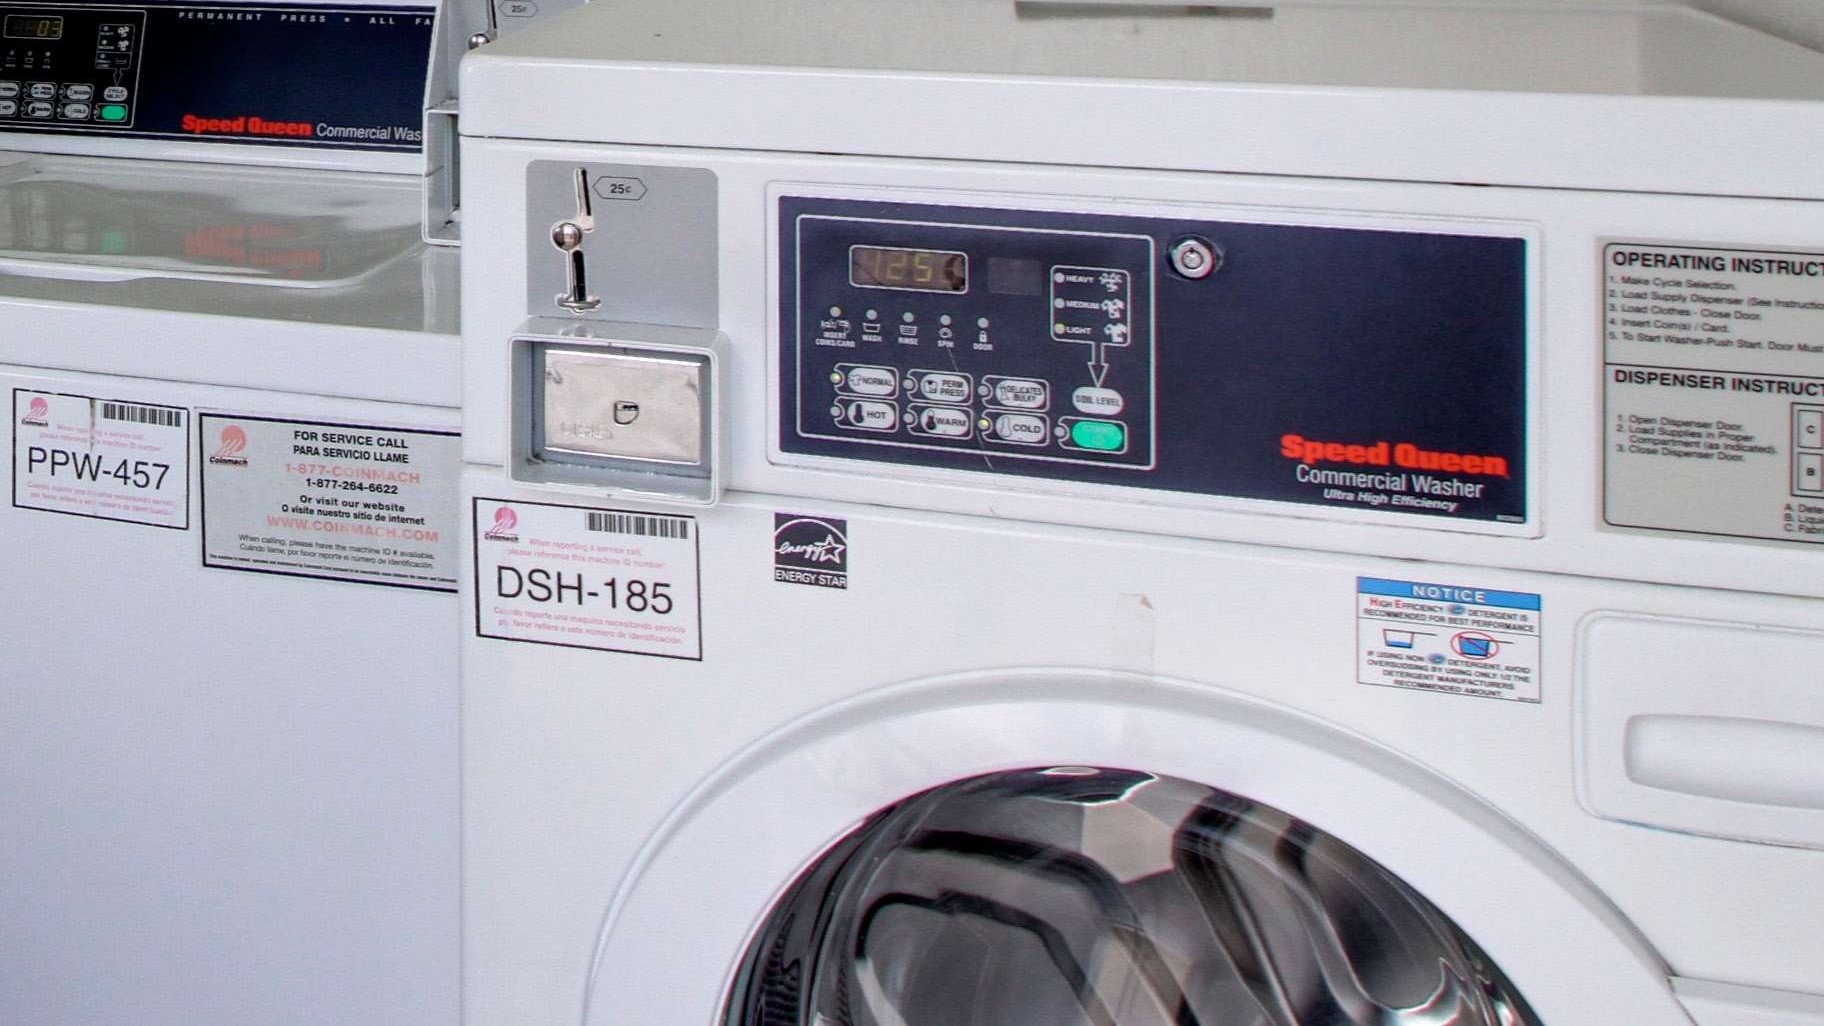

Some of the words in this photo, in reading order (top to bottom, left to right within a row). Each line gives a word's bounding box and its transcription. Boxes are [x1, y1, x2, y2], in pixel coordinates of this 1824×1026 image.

[179, 12, 263, 20] PERMANENT
[182, 115, 244, 133] Speed
[249, 117, 313, 136] Queen
[317, 123, 391, 140] Commercial
[610, 183, 632, 193] 25¢
[867, 252, 932, 281] 125
[1613, 252, 1725, 271] OPERATING
[1066, 274, 1094, 283] HEAVY
[1622, 276, 1649, 286] Make
[1653, 277, 1682, 288] Cycle
[1686, 279, 1737, 290] Selection.
[1066, 299, 1100, 309] MEDIUM
[1621, 291, 1648, 300] Load
[1651, 292, 1686, 302] Supply
[1691, 294, 1743, 306] Dispenser
[1621, 305, 1648, 314] Load
[1651, 305, 1690, 316] Clothes
[1700, 309, 1731, 319] Close
[1066, 326, 1092, 335] LIGHT
[1621, 319, 1651, 328] Insert
[815, 339, 855, 347] COINS/CARD
[898, 337, 918, 345] RINSE
[1623, 332, 1633, 341] To
[1637, 333, 1661, 343] Start
[1768, 341, 1793, 351] Door
[1797, 343, 1823, 353] Must
[862, 377, 893, 386] NORMAL
[942, 380, 964, 388] PERM
[1615, 370, 1725, 390] DISPENSER
[940, 388, 965, 397] PRESS
[1007, 386, 1042, 395] DELICATES
[1076, 395, 1093, 403] SOIL
[1096, 397, 1119, 406] LEVEL
[867, 410, 887, 419] HOT
[936, 417, 967, 426] WARM
[1629, 415, 1656, 425] Open
[1661, 418, 1712, 429] Dispenser
[1013, 424, 1041, 433] COLD
[1629, 426, 1654, 435] Load
[1658, 427, 1703, 439] Supplies
[1706, 430, 1715, 438] in
[1718, 432, 1754, 443] Proper
[1807, 425, 1815, 433] C
[294, 431, 318, 442] FOR
[322, 433, 373, 446] SERVICE
[377, 437, 408, 449] CALL
[1629, 435, 1700, 448] Compartment
[293, 446, 320, 456] PARA
[323, 448, 370, 460] SERVICIO
[374, 451, 409, 464] LLAME
[1281, 434, 1390, 465] Speed
[1394, 443, 1509, 478] Queen
[1629, 445, 1658, 456] Close
[1661, 447, 1715, 460] Dispenser
[29, 446, 170, 490] PPW-457
[210, 456, 248, 467] Coinmach
[285, 463, 420, 484] 1-877-COINMACH
[1807, 468, 1815, 476] B
[306, 478, 398, 495] 1-877-264-6622
[1296, 464, 1406, 491] Commercial
[1412, 474, 1484, 498] Washer
[300, 494, 312, 504] Or
[315, 495, 338, 506] visit
[342, 499, 359, 509] our
[363, 500, 405, 513] website
[1323, 488, 1354, 501] Ultra
[1358, 492, 1388, 506] High
[1392, 495, 1457, 512] Efficiency
[281, 504, 288, 513] O
[317, 508, 350, 519] nuestro
[353, 510, 372, 521] sitio
[375, 512, 386, 522] de
[388, 514, 425, 525] internet
[266, 515, 439, 543] WWW.COINMACH.COM
[239, 534, 259, 543] When
[262, 536, 287, 547] calling,
[289, 540, 313, 549] please
[315, 542, 334, 550] have
[336, 543, 347, 551] the
[349, 544, 380, 554] machine
[382, 547, 390, 555] ID
[776, 570, 816, 583] ENERGY
[818, 575, 847, 586] STAR
[497, 565, 672, 614] DSH-185
[1412, 586, 1486, 603] NOTICE
[1395, 599, 1443, 613] EFFICIENCY
[1468, 609, 1517, 620] DETERGENT
[1364, 608, 1426, 621] RECOMMENDED
[1429, 615, 1445, 623] FOR
[1448, 617, 1469, 625] BEST
[1472, 619, 1534, 632] PERFORMANCE
[1376, 652, 1403, 661] USING
[1406, 654, 1424, 662] NON
[1504, 665, 1530, 674] AVOID
[1383, 670, 1435, 681] DETERGENT
[1437, 675, 1515, 690] MANUFACTURERS
[1445, 667, 1472, 676] USING
[1475, 671, 1497, 679] ONLY
[1393, 679, 1462, 693] RECOMMENDED
